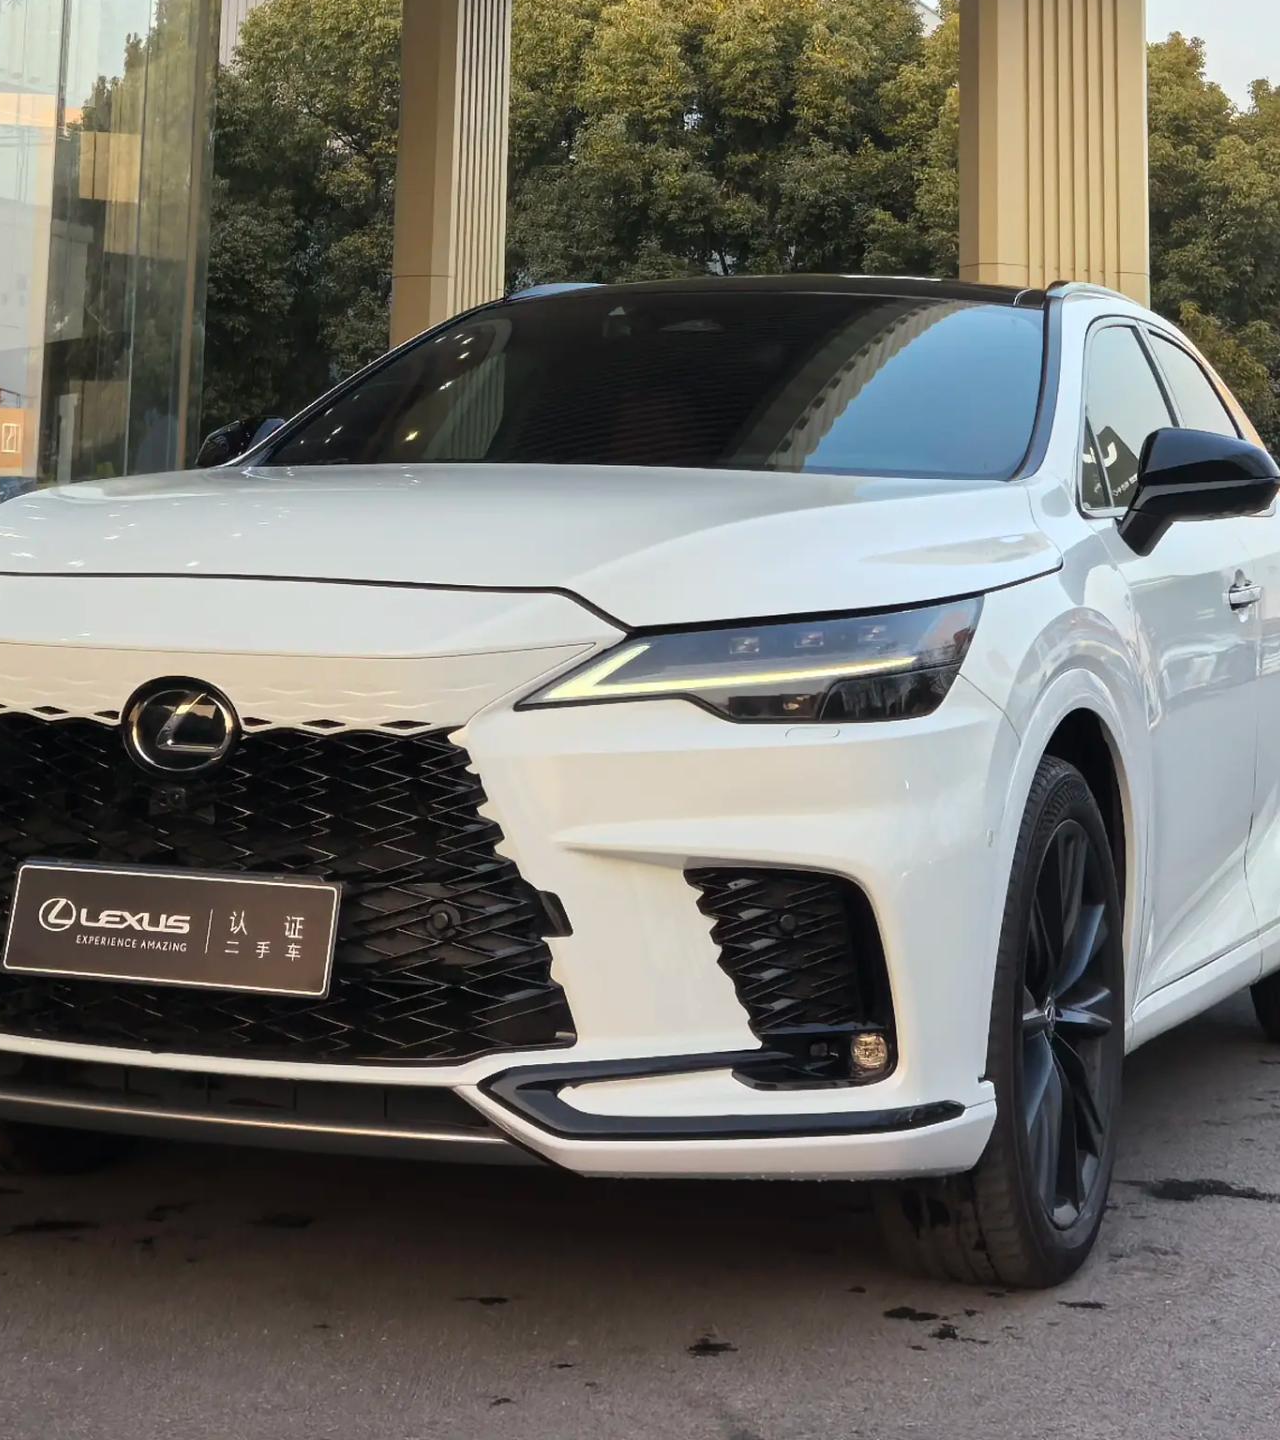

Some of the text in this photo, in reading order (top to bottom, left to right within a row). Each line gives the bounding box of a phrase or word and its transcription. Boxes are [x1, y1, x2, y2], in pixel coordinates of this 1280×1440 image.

[80, 909, 191, 934] LEXUS
[76, 935, 187, 952] EXPERIENCE AMAZING
[225, 941, 301, 962] 二手车
